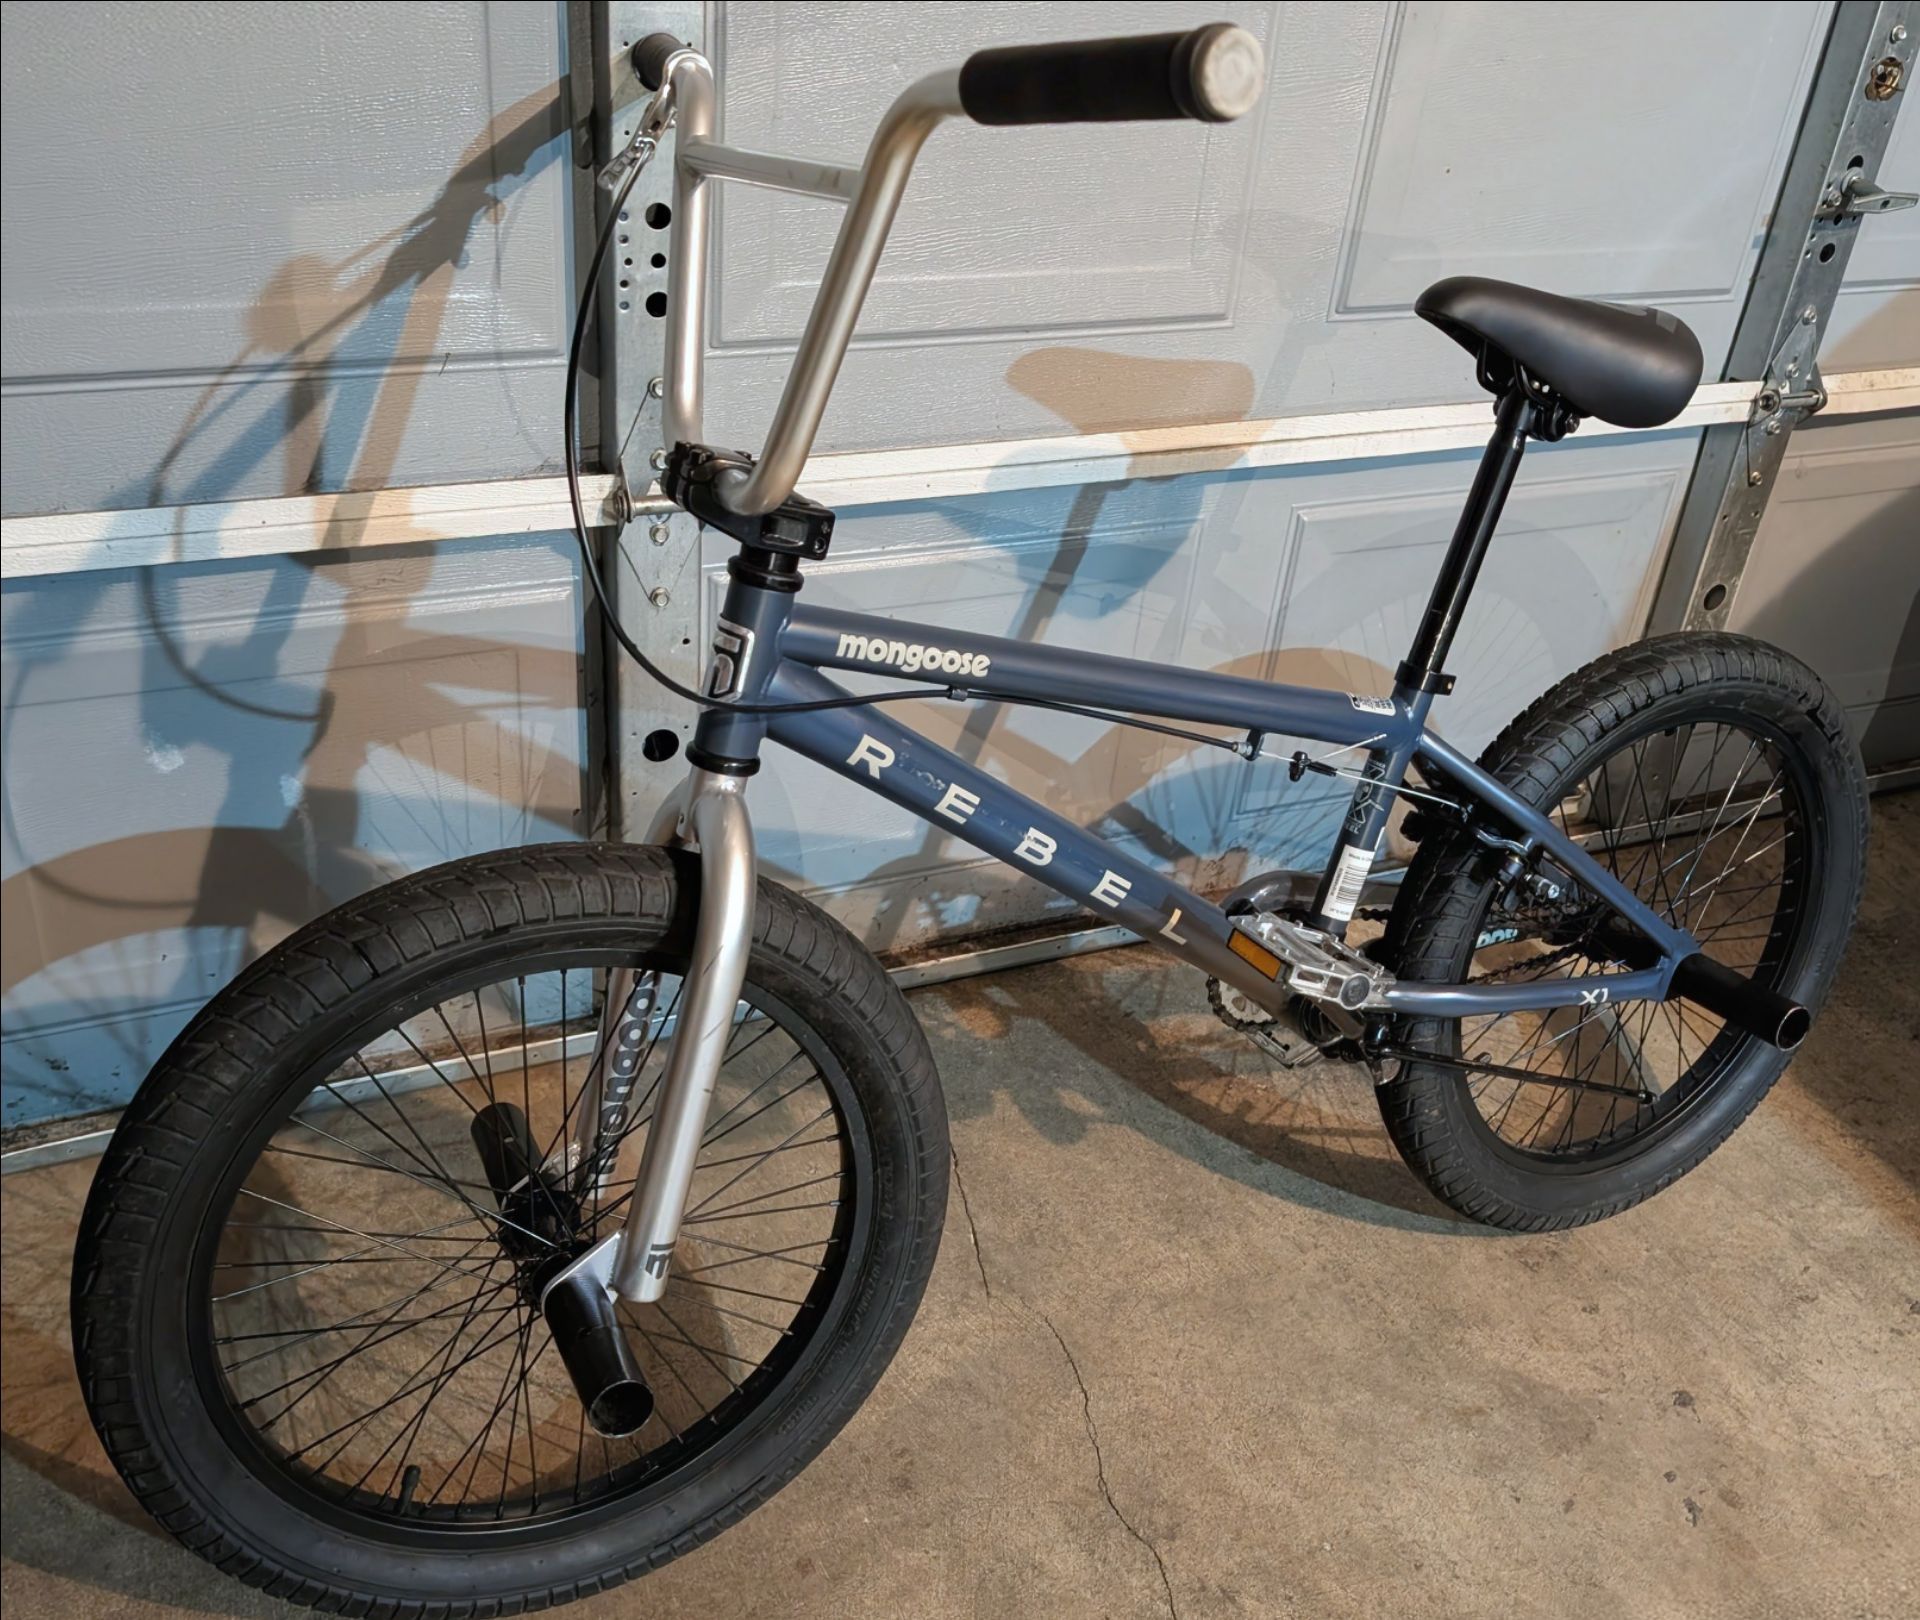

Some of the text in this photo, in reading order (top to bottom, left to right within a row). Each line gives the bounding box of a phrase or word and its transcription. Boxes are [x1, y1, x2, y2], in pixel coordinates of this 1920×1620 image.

[836, 633, 991, 678] mongoose
[846, 734, 1188, 945] REBEL
[1578, 988, 1609, 1006] X1
